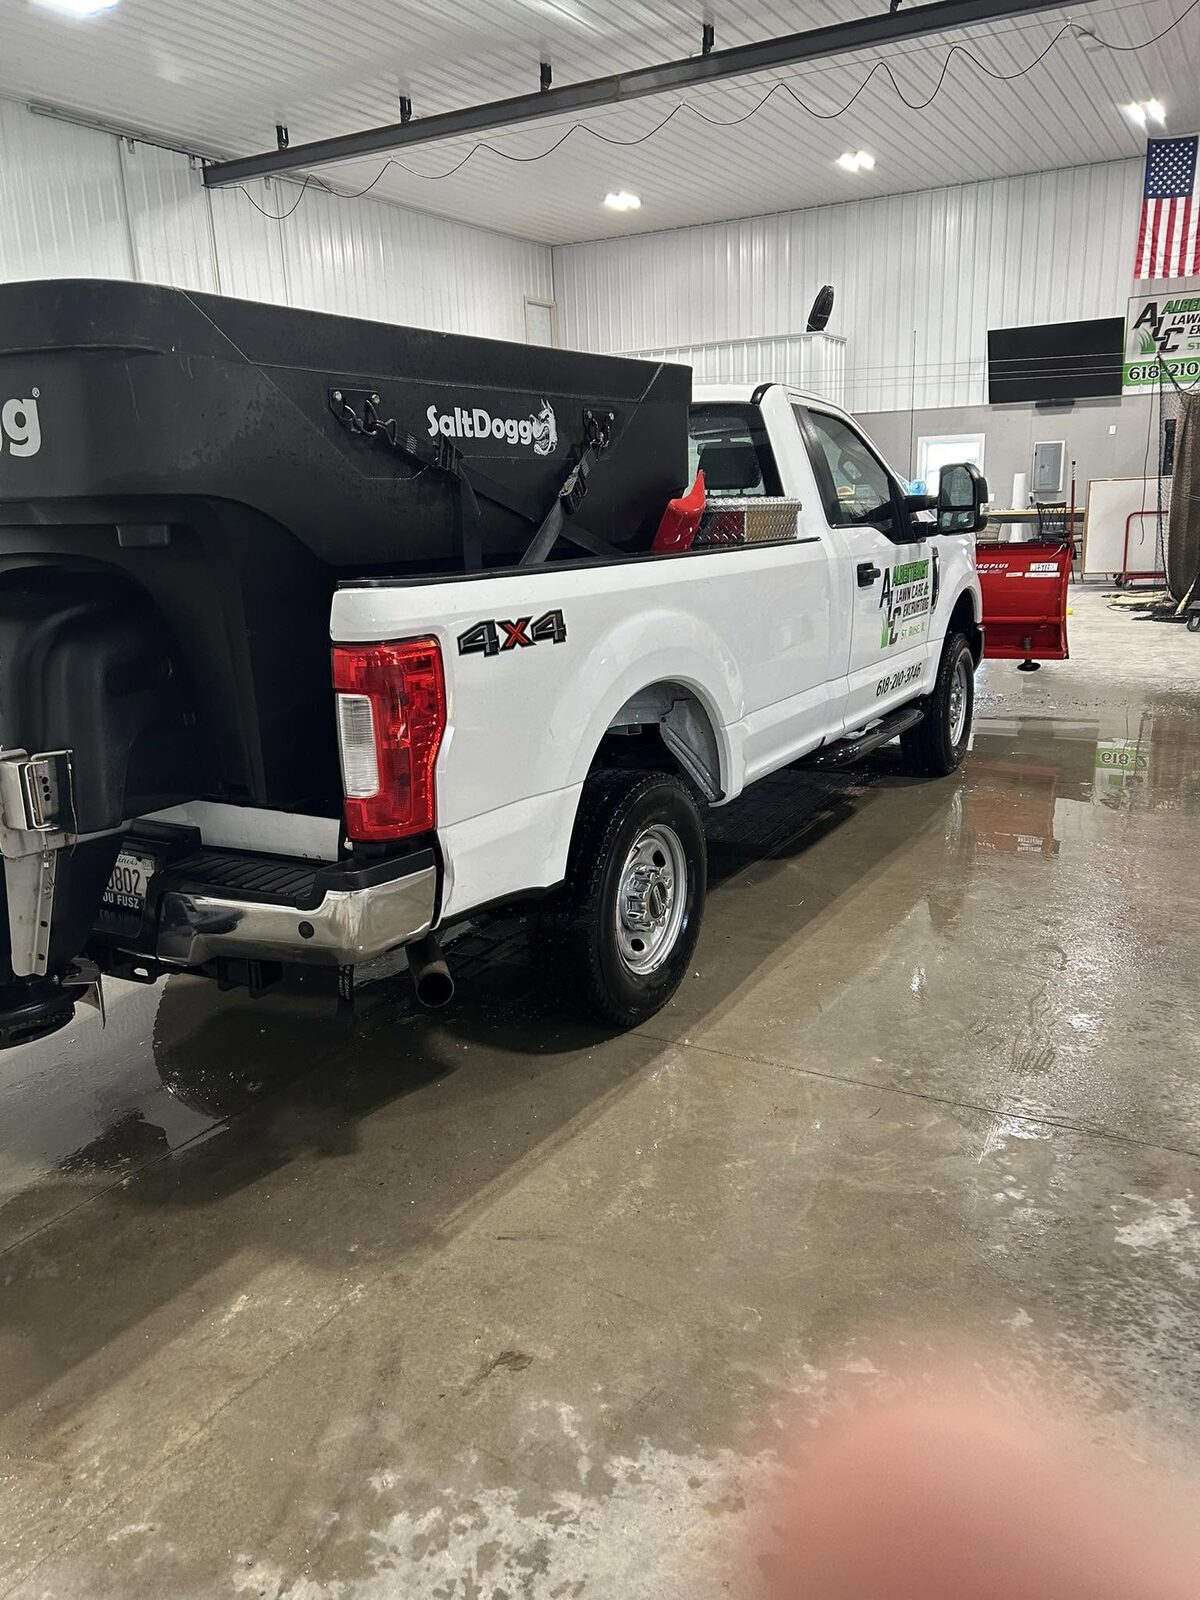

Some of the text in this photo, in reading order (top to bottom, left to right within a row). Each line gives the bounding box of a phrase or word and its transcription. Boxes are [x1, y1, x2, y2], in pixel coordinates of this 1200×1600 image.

[1171, 312, 1200, 326] LAW
[426, 404, 534, 445] SaltDogg
[1030, 562, 1059, 571] WESTERN
[895, 586, 912, 604] LAWN
[911, 582, 924, 599] CARE
[876, 662, 922, 696] 618-210-3746
[117, 895, 139, 909] FUSZ
